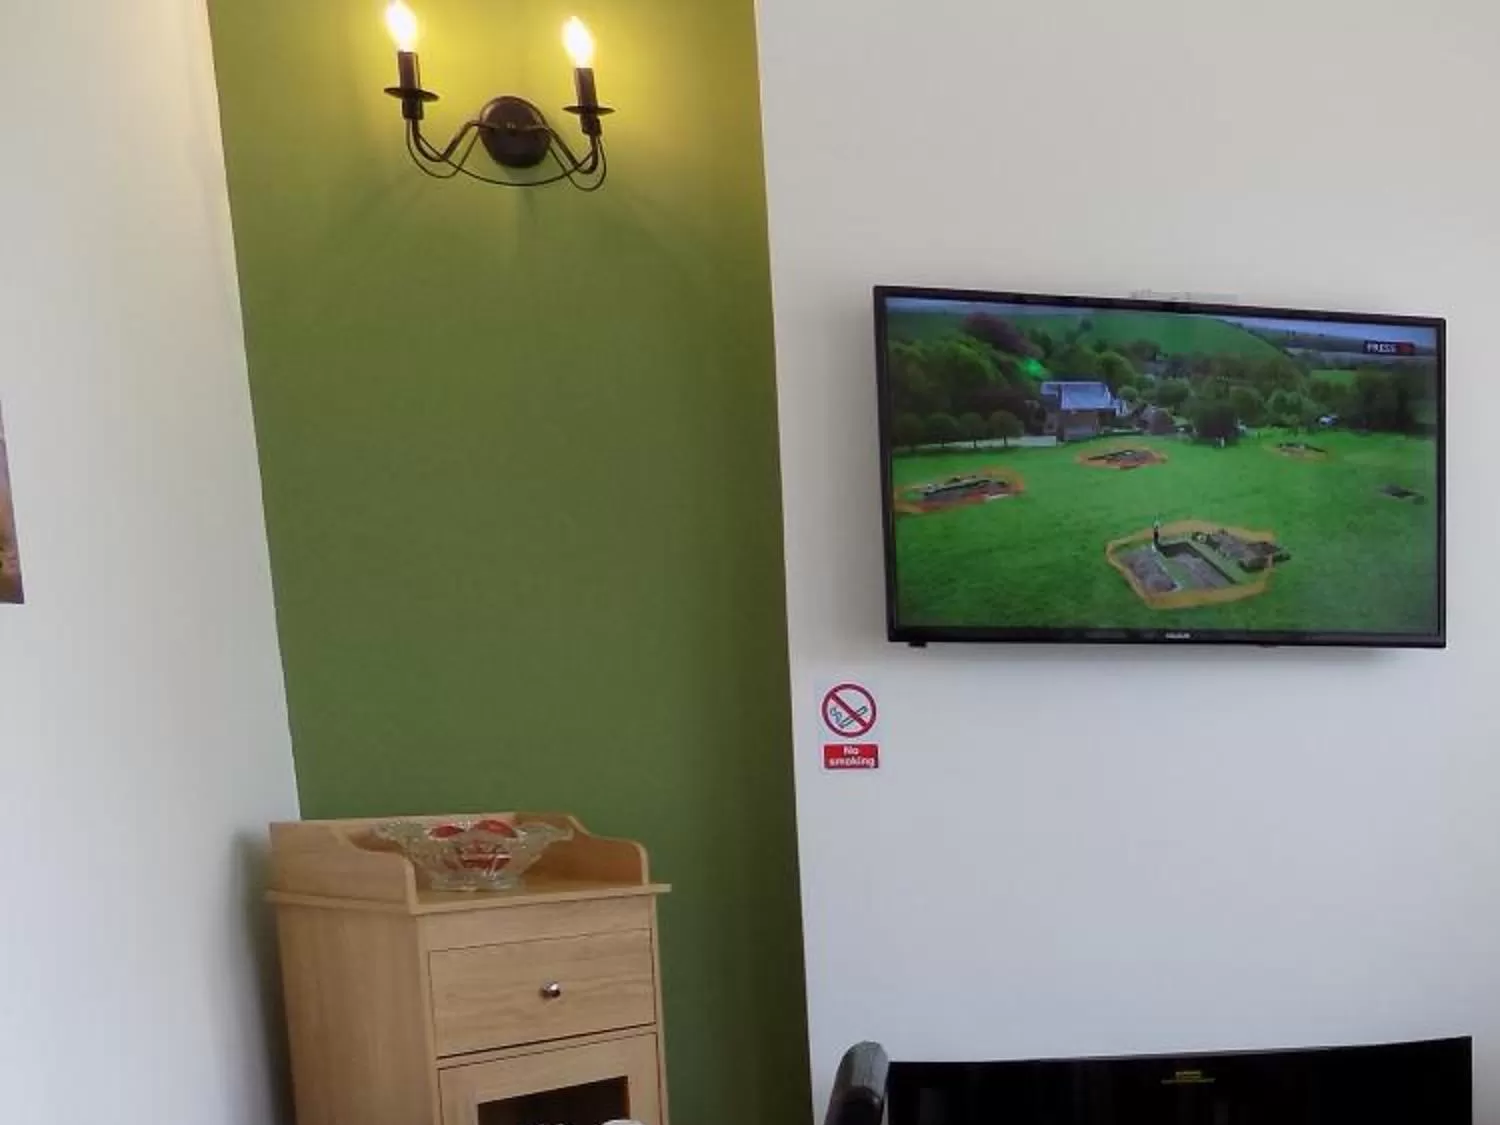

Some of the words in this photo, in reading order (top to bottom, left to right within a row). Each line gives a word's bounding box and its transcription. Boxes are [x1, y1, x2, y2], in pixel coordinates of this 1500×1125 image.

[1367, 343, 1397, 353] PRESS
[843, 745, 860, 756] No
[829, 756, 875, 767] smoking
